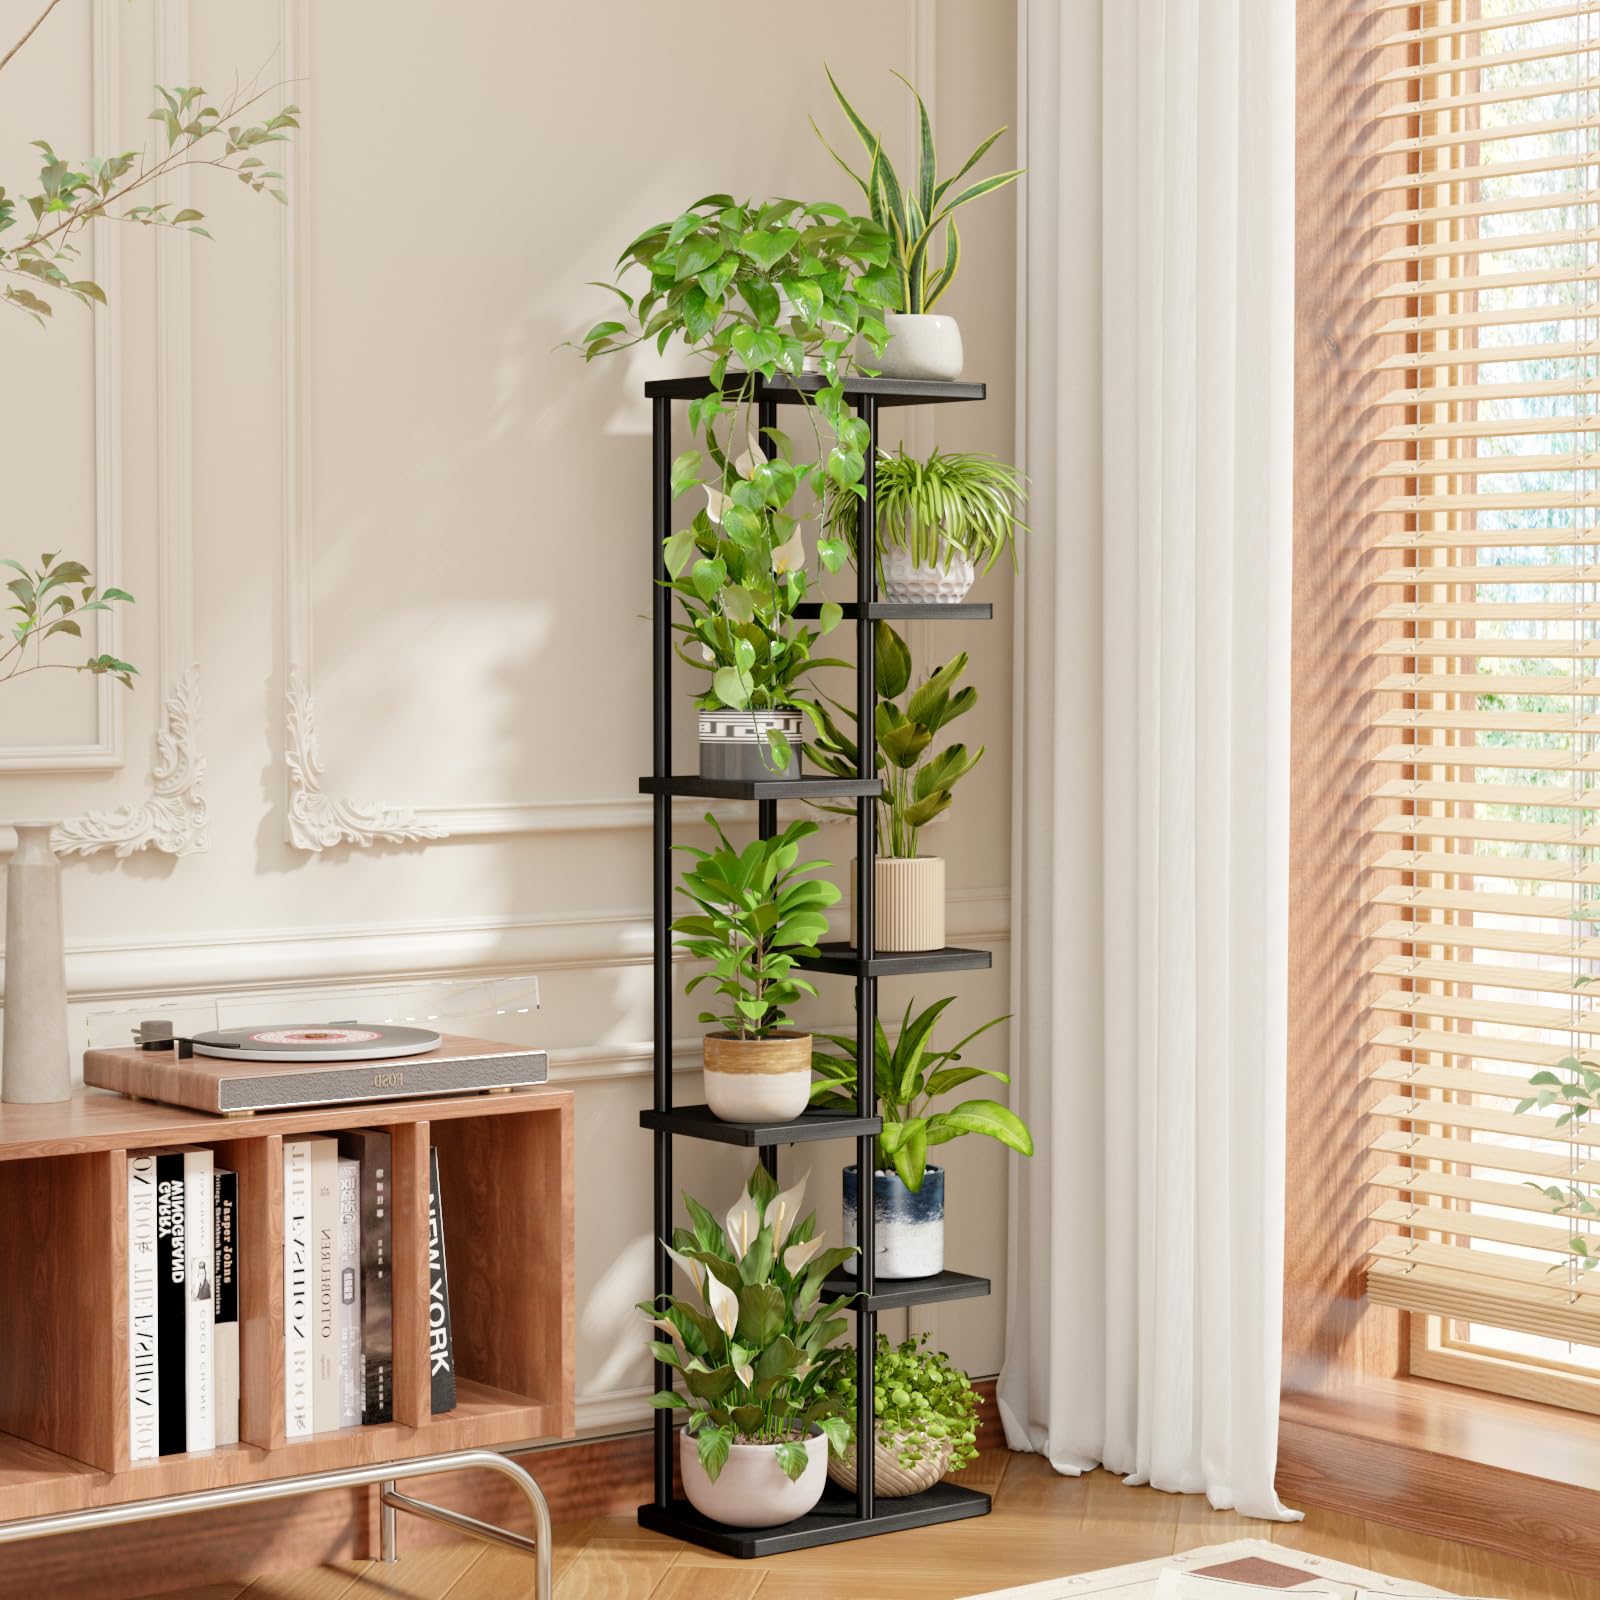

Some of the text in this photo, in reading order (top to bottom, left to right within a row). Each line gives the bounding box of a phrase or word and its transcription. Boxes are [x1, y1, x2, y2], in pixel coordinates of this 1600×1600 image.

[221, 1200, 233, 1284] Jasper Johns
[430, 1277, 450, 1377] YORK
